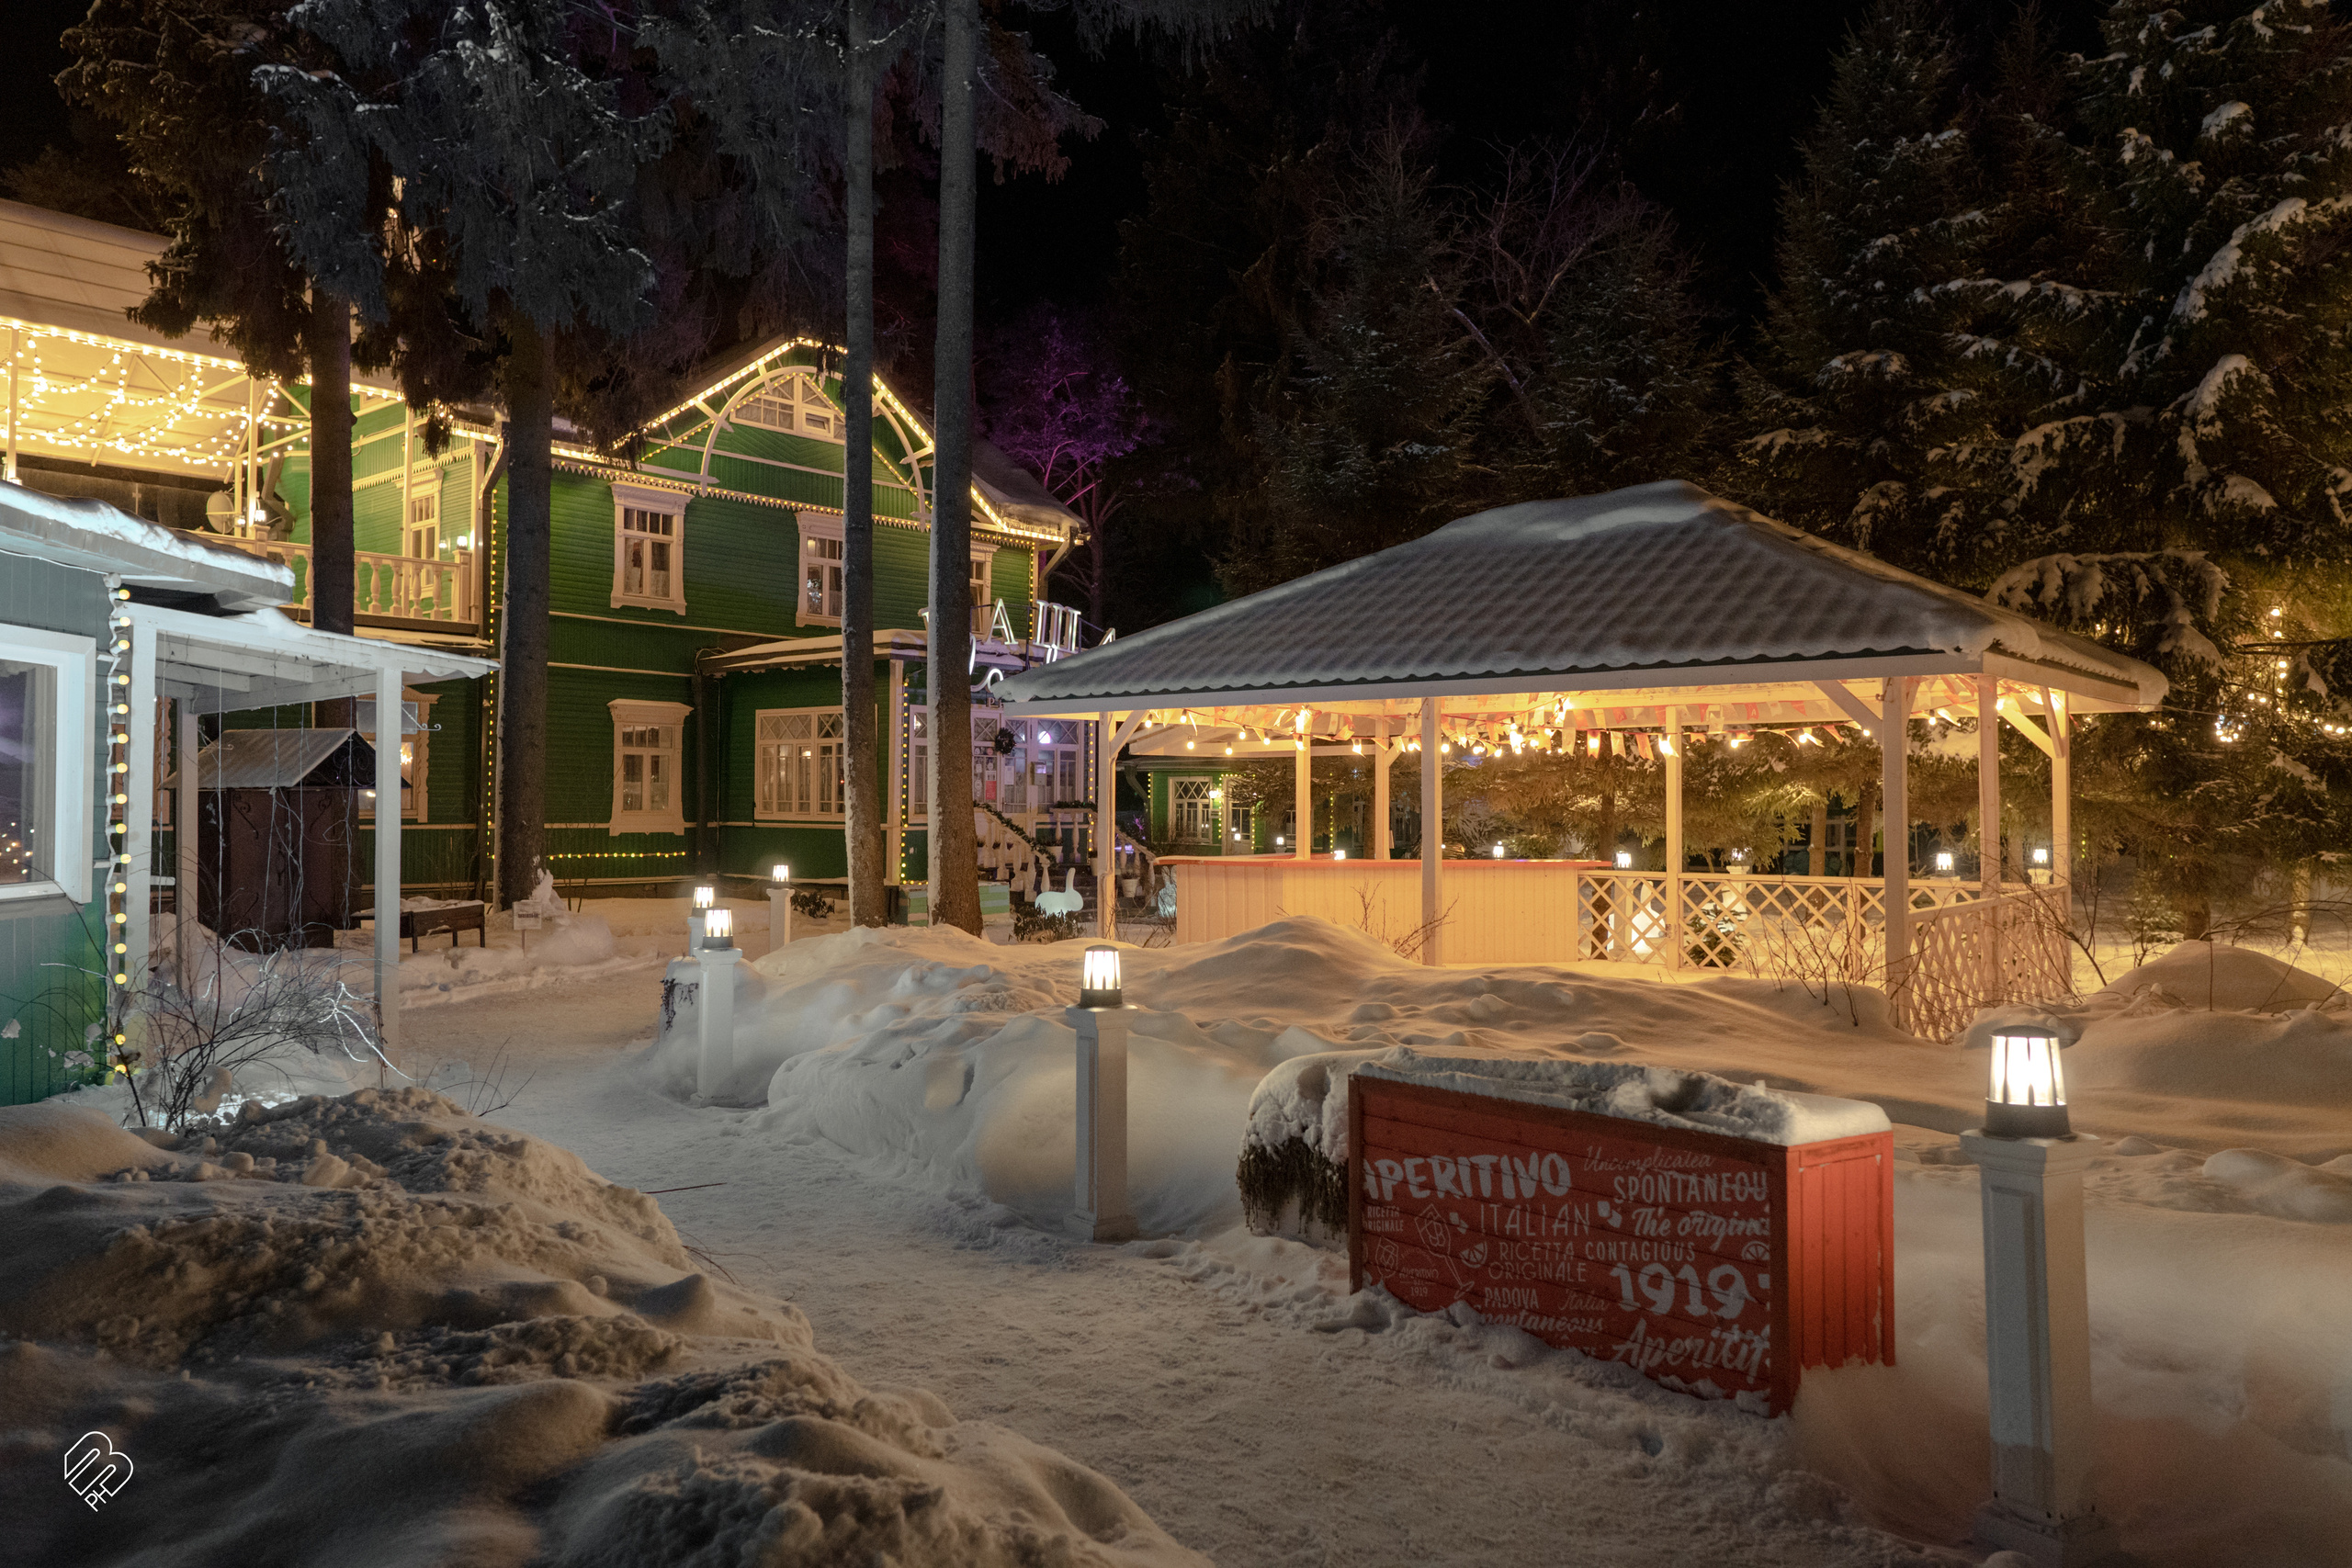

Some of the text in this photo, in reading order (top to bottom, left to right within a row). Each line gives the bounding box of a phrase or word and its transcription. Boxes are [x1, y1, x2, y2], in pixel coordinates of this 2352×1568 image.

[1366, 1205, 1400, 1218] RICETTA
[1480, 1203, 1591, 1236] ITALIAN
[1632, 1206, 1671, 1236] The
[1499, 1241, 1575, 1261] RICETTA
[1585, 1241, 1696, 1262] CONTAGIOUS
[1488, 1262, 1587, 1282] ORIGINALE
[1410, 1287, 1429, 1297] 1919
[1485, 1287, 1539, 1309] PADOVA
[1610, 1262, 1749, 1319] 1919
